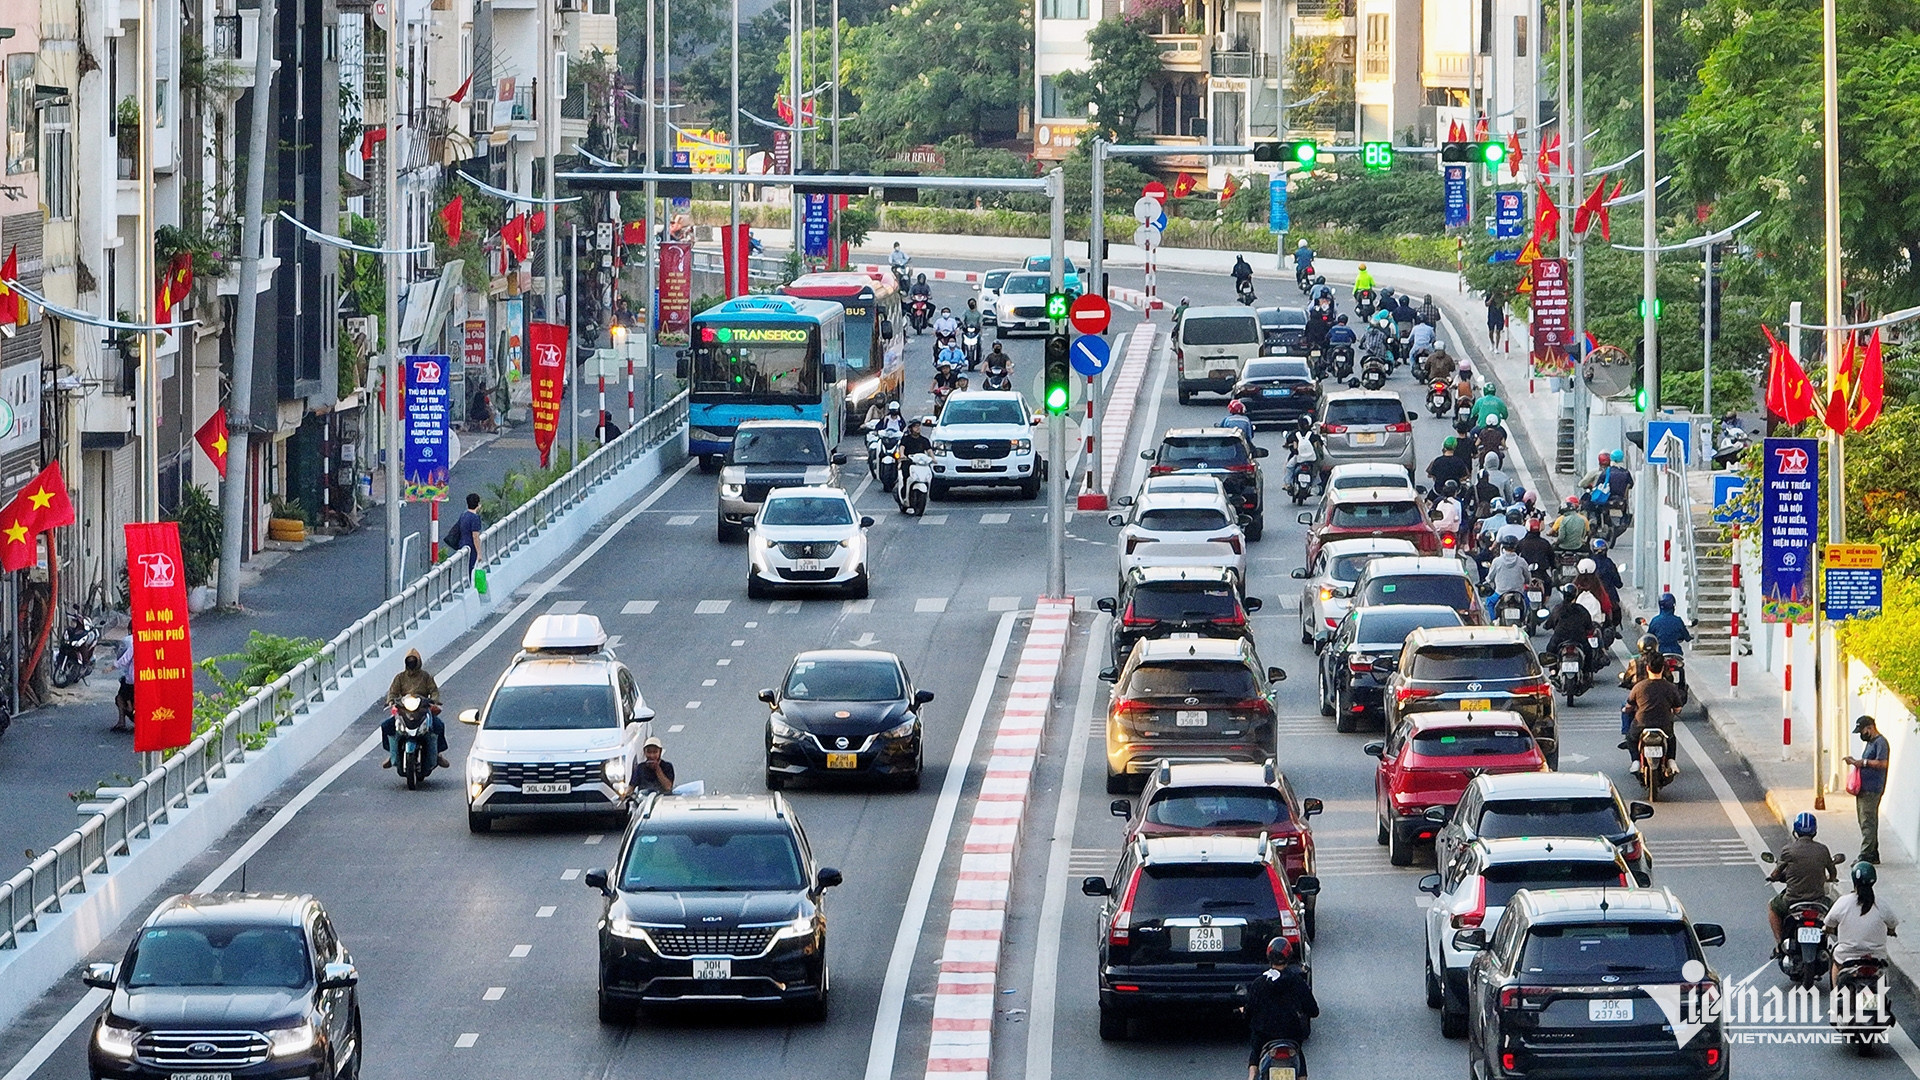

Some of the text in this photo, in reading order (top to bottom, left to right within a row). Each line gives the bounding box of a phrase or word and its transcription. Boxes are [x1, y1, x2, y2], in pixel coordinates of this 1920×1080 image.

[1366, 143, 1391, 164] 86
[846, 308, 866, 316] BUS
[732, 329, 807, 342] TRANSERCO
[413, 361, 441, 383] 70
[1775, 447, 1809, 475] 70
[1771, 479, 1811, 490] PHÁT TRIỂN
[1779, 491, 1803, 501] THỦ ĐÔ
[1779, 503, 1803, 514] HÀ NỘI
[1773, 514, 1788, 524] VĂN
[1772, 526, 1787, 536] VĂN
[1773, 537, 1790, 549] HIỆN
[1791, 538, 1803, 549] ĐẠI
[138, 552, 175, 588] 70
[157, 608, 173, 624] NỘI
[137, 624, 184, 642] THÀNH PHỐ
[155, 647, 165, 661] VÌ
[139, 669, 156, 681] HÒA
[157, 667, 179, 680] BÌNH
[1197, 929, 1215, 939] 29A
[1190, 939, 1221, 950] 626.88
[704, 960, 721, 970] 30H
[1602, 1000, 1620, 1009] 30K
[1594, 1010, 1629, 1019] 237.98
